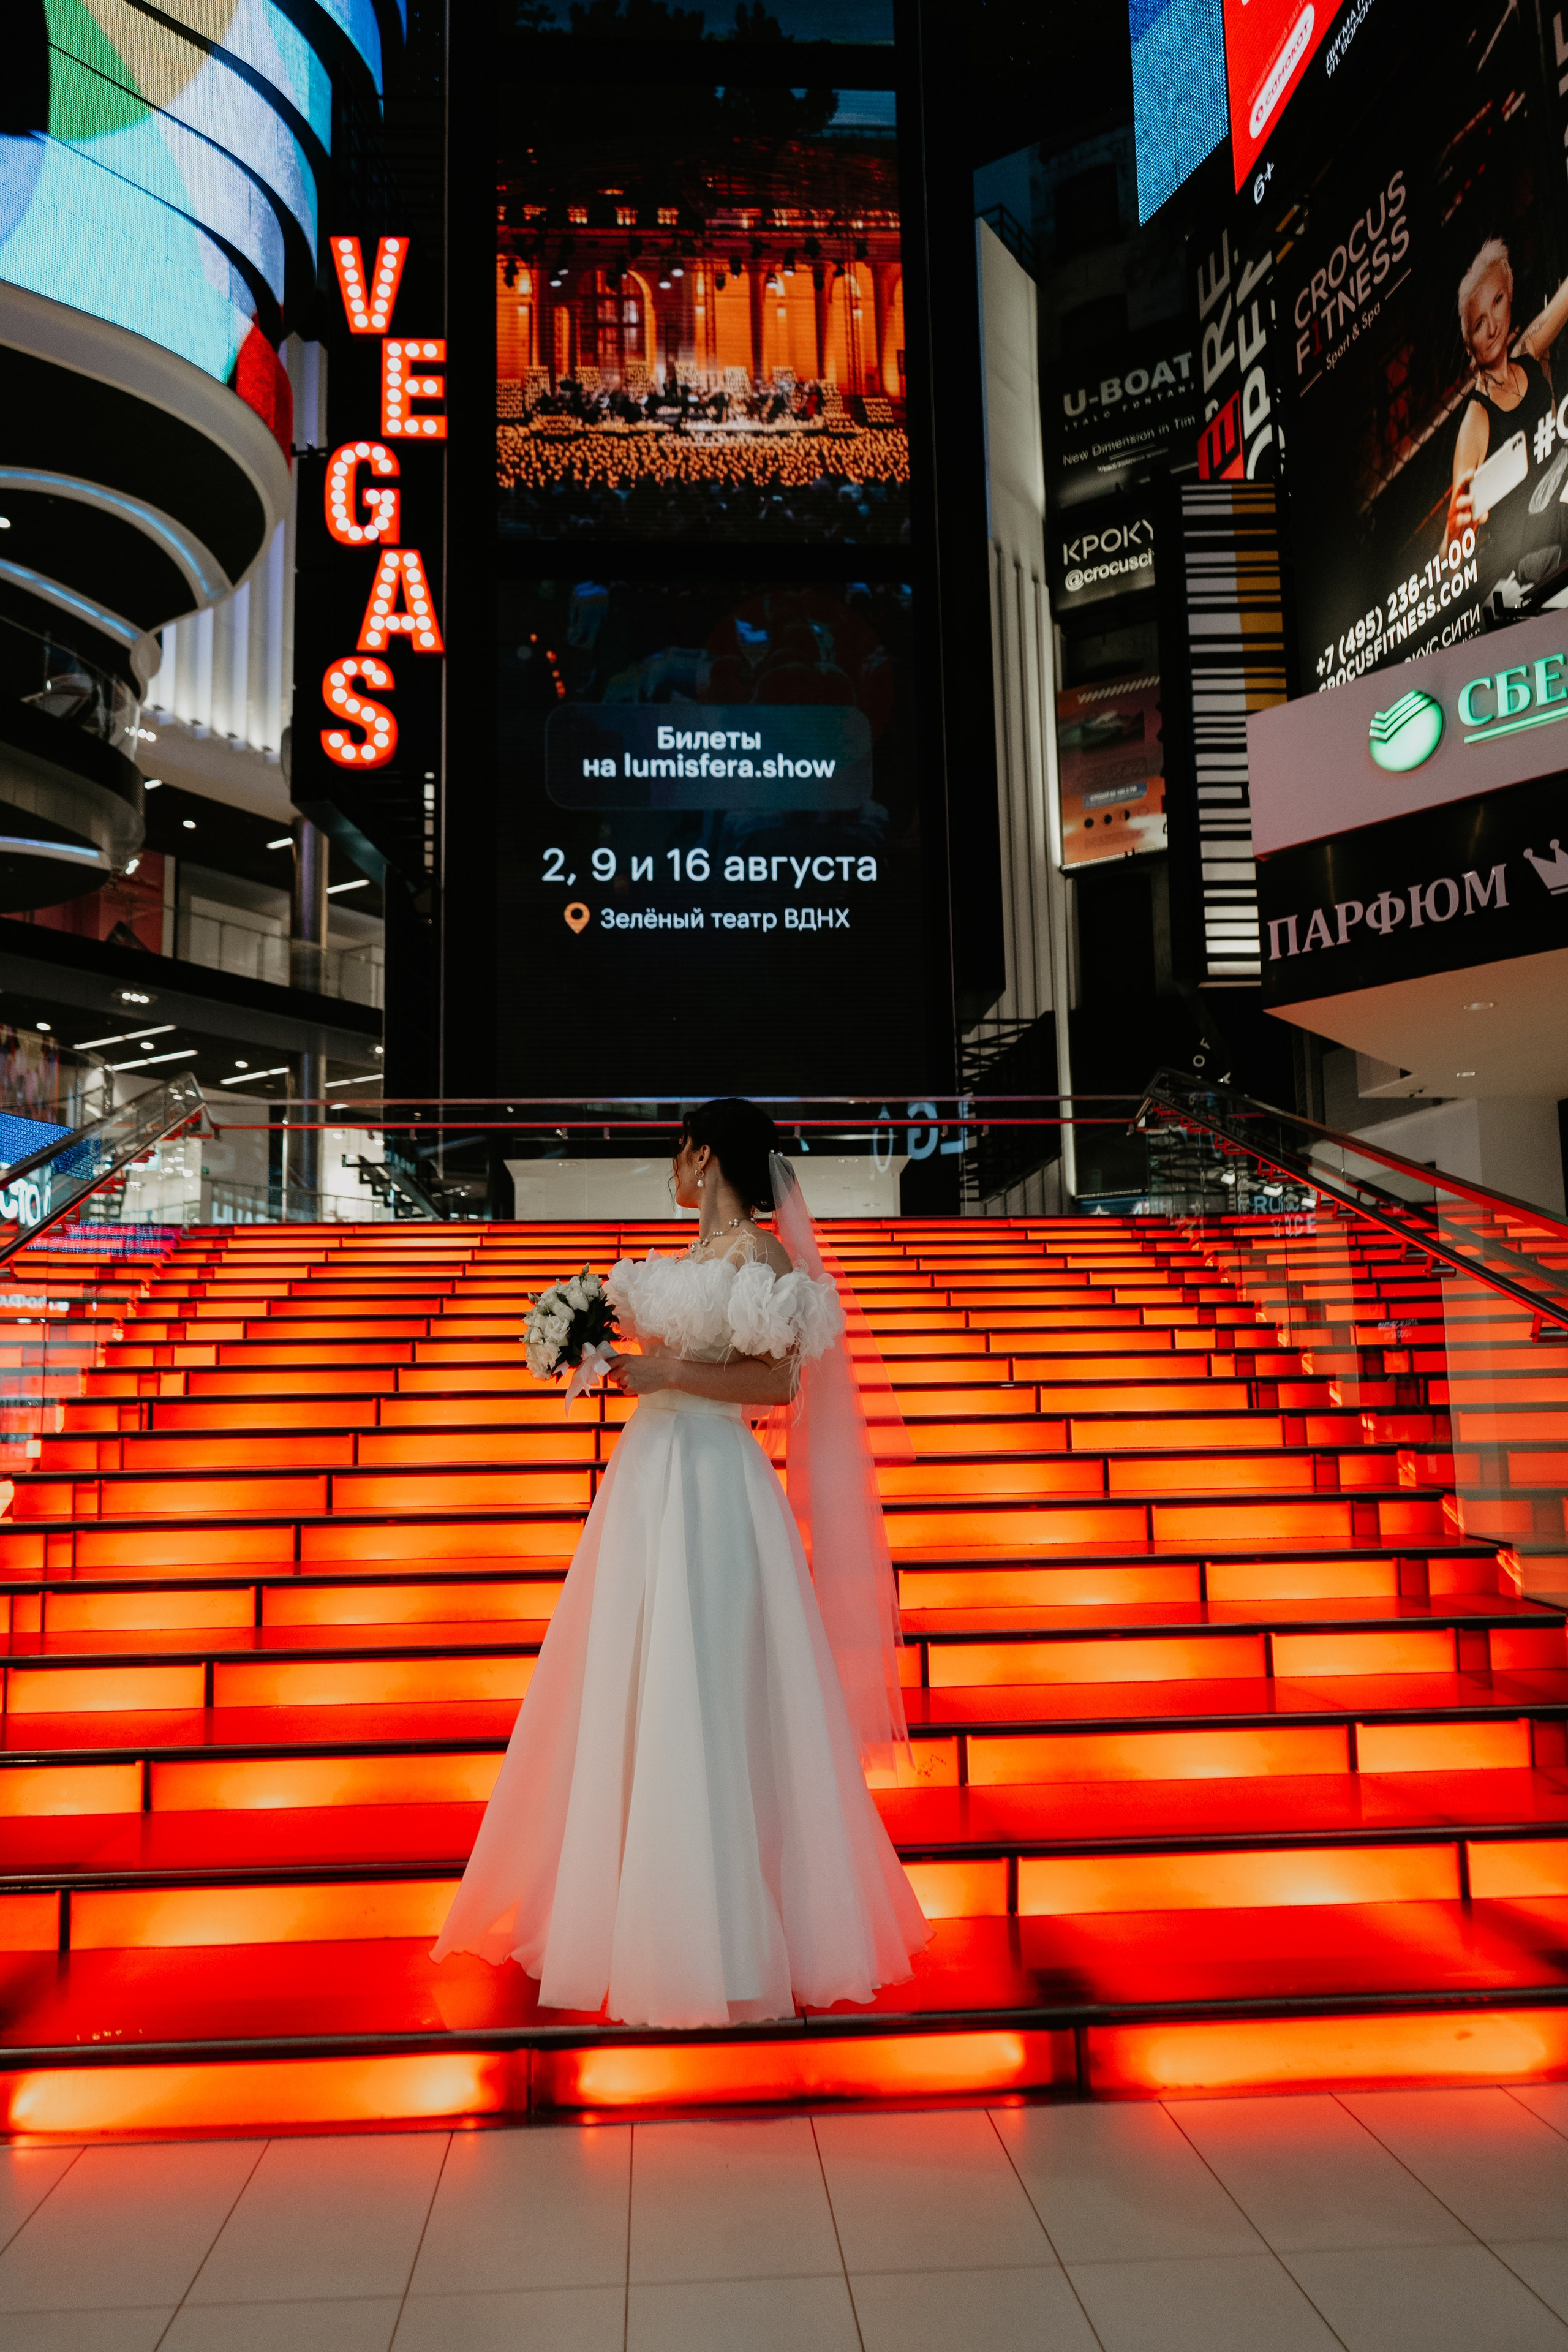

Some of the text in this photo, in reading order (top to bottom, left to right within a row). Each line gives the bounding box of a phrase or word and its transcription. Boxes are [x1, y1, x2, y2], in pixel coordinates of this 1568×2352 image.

[1341, 0, 1373, 55] ВОРОН
[1254, 162, 1274, 205] 6+
[1294, 170, 1406, 330] CROCUS
[1325, 334, 1350, 371] Sport
[1362, 301, 1381, 331] Spa
[1063, 351, 1193, 418] U-BOAT
[1063, 450, 1089, 466] New
[1092, 428, 1155, 457] Dimension
[1158, 423, 1170, 435] in
[319, 236, 448, 770] VEGAS
[1065, 548, 1155, 592] @crocusci
[1316, 527, 1476, 677] +7 (495) 236-11-00
[1442, 603, 1480, 647] СИТИ
[1458, 652, 1568, 726] СБЕ
[657, 726, 761, 751] Билеты
[582, 753, 836, 778] на lumisfera.show
[542, 848, 878, 889] 2, 9 и 16 августа
[600, 907, 850, 932] Зелёный театр ВДНХ
[1267, 863, 1510, 960] ПАРФЮМ
